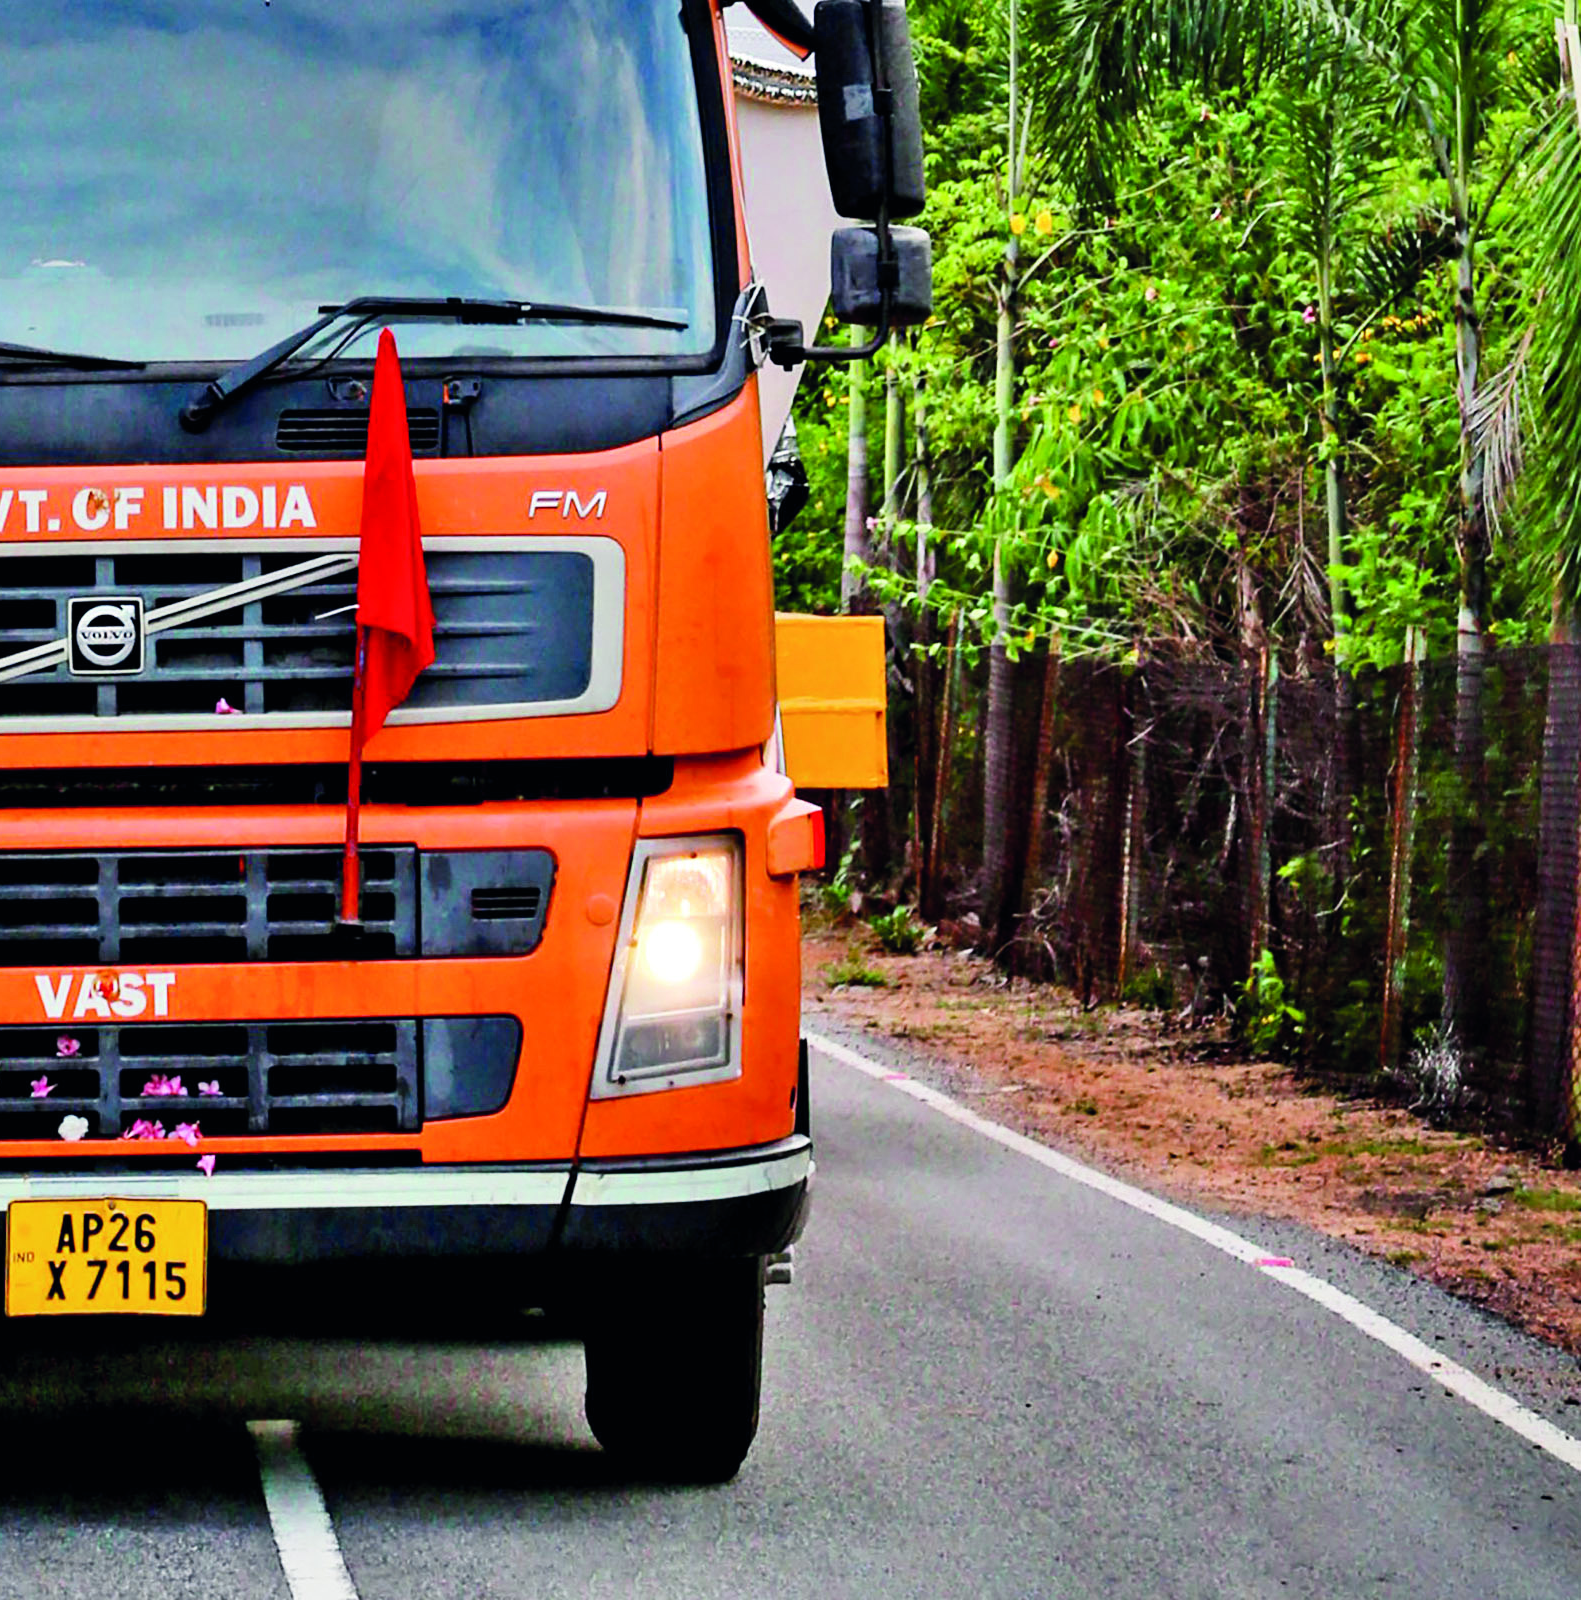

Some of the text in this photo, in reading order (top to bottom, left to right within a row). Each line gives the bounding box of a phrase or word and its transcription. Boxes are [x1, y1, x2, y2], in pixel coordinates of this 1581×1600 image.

[73, 487, 145, 531] OF
[164, 485, 318, 530] INDIA
[528, 490, 608, 519] FM
[80, 630, 133, 640] VOLVO
[34, 972, 176, 1018] VAST
[56, 1213, 156, 1253] AP26
[12, 1251, 35, 1263] IND
[46, 1260, 187, 1300] X 7115
